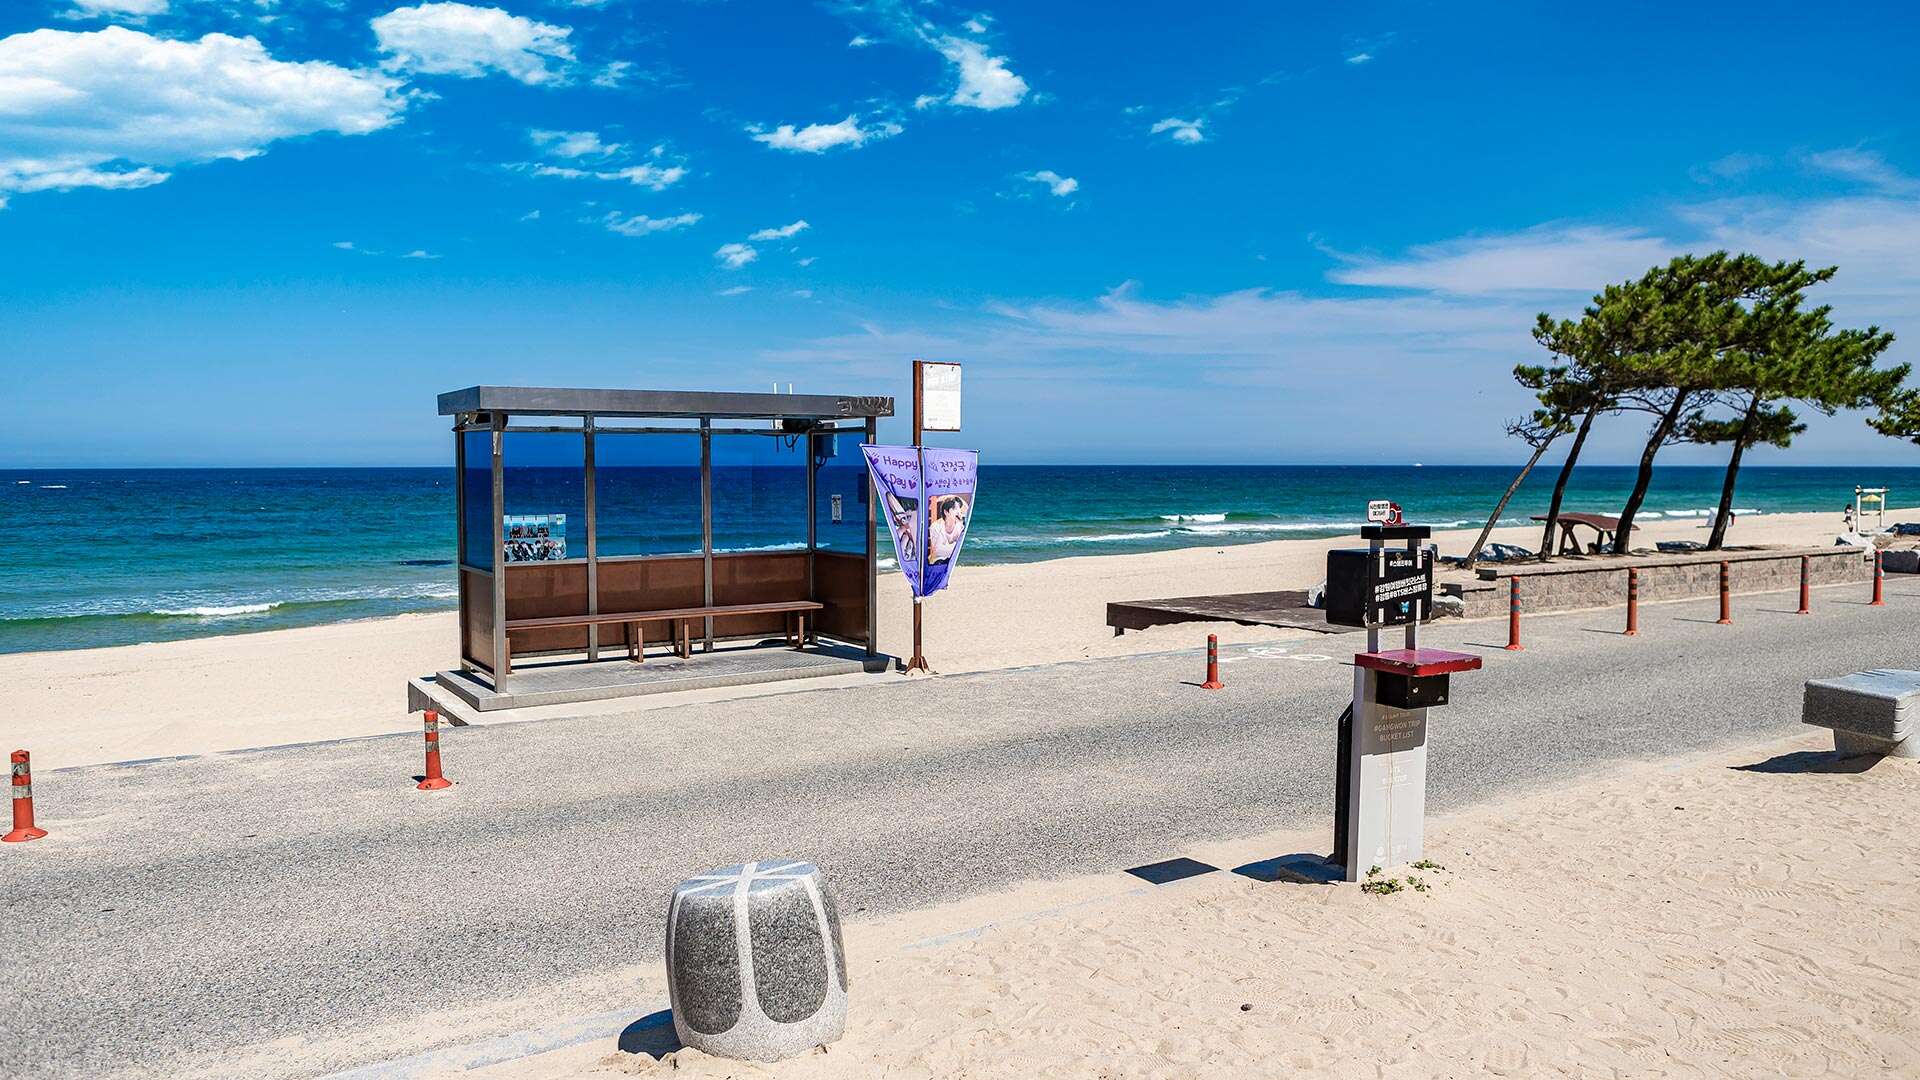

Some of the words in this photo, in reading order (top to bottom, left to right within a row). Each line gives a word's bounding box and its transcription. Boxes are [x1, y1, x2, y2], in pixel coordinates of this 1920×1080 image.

[883, 456, 918, 470] Happy
[940, 460, 966, 473] 전정국
[889, 473, 907, 489] Day
[1379, 732, 1401, 742] BUCKET
[1403, 730, 1414, 739] LIST
